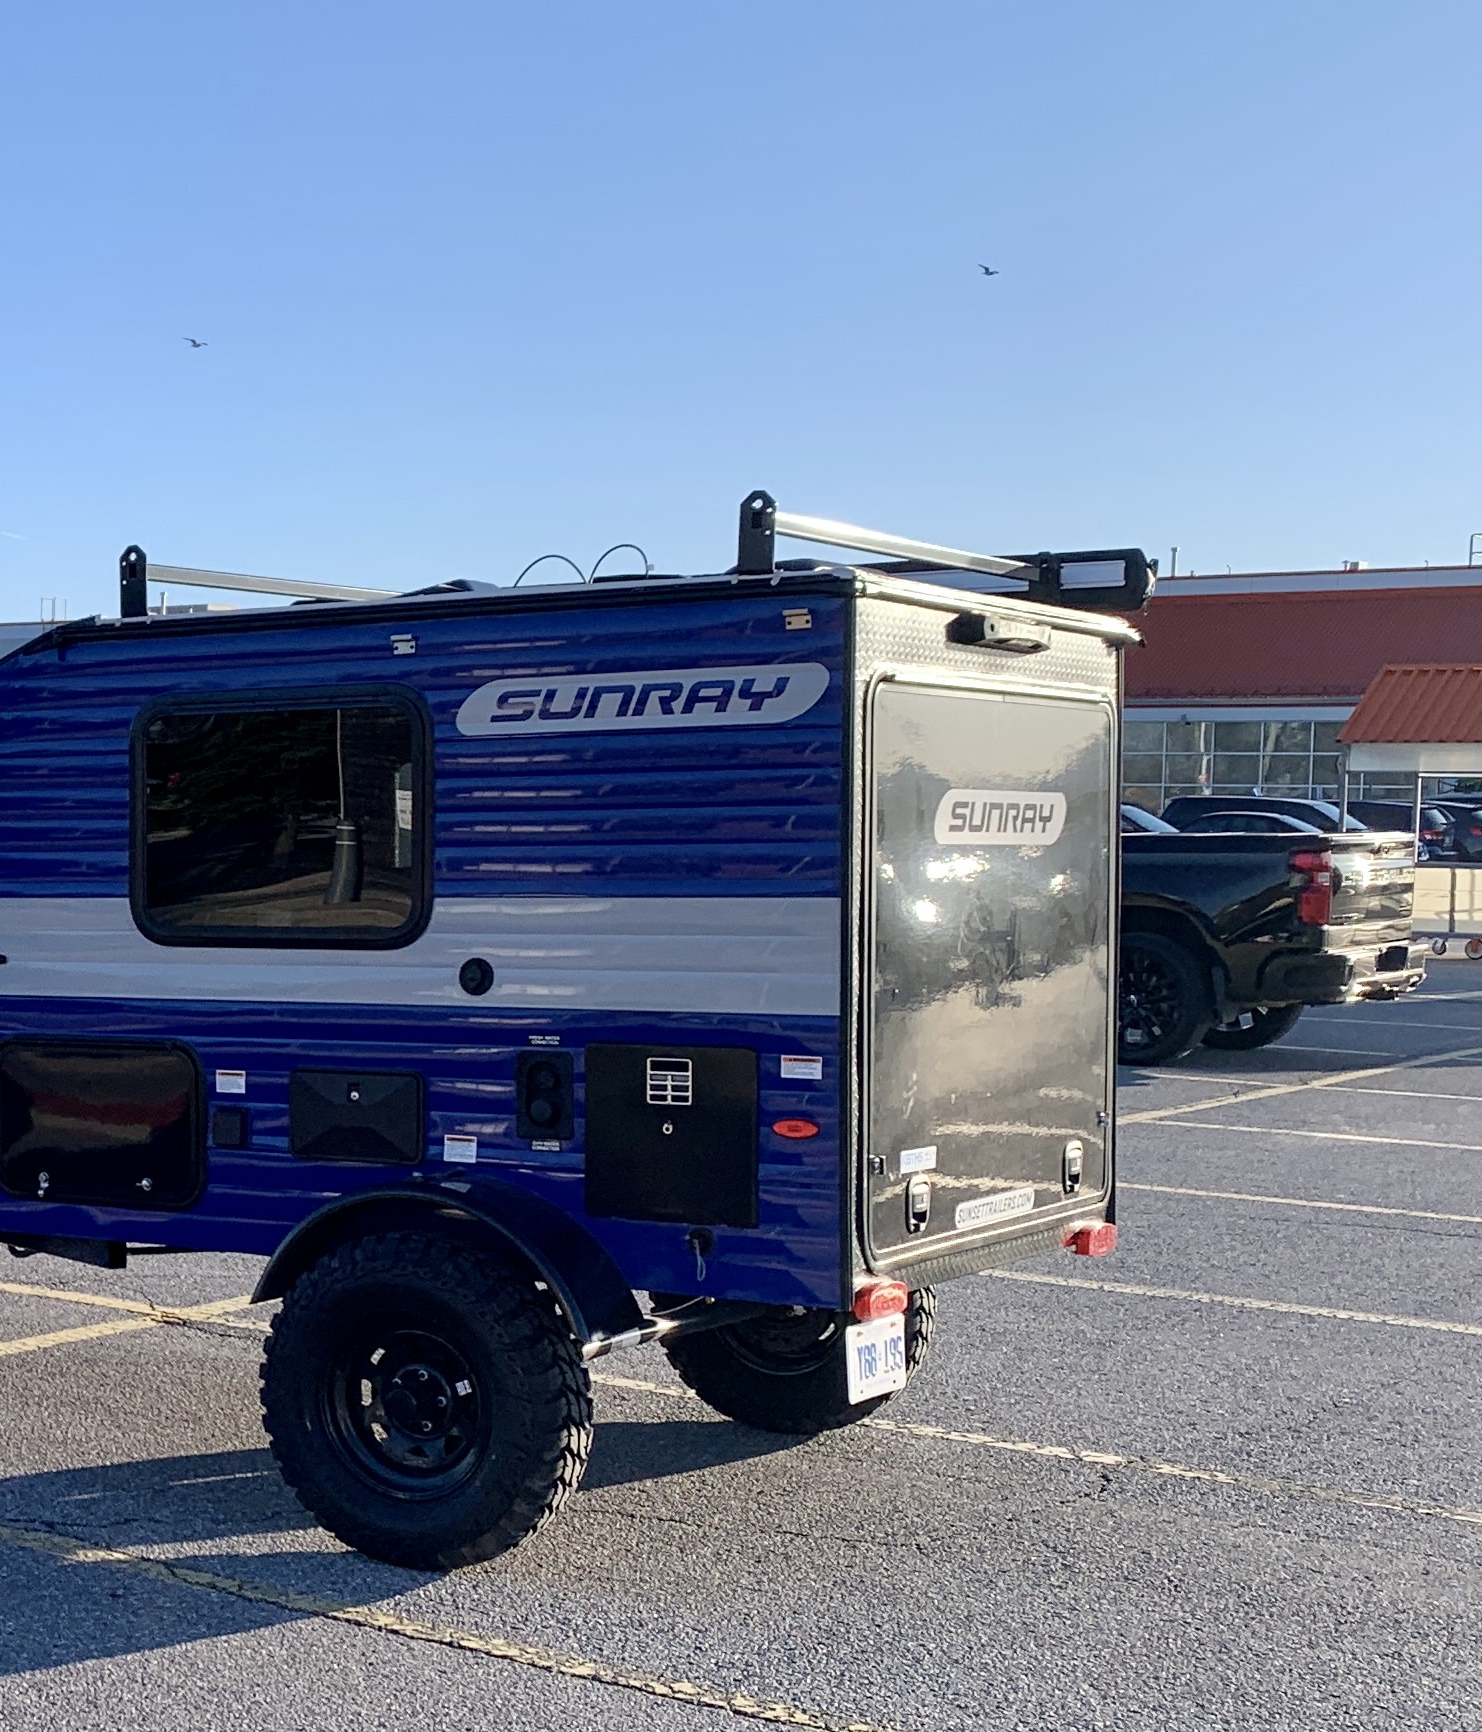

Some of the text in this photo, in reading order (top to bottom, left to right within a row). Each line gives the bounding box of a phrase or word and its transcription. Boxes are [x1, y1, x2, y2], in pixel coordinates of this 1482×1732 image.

[490, 676, 790, 723] SUNRAY
[949, 801, 1054, 833] SUNRAY
[957, 1191, 1033, 1224] SUNSETTRAILERS.COM
